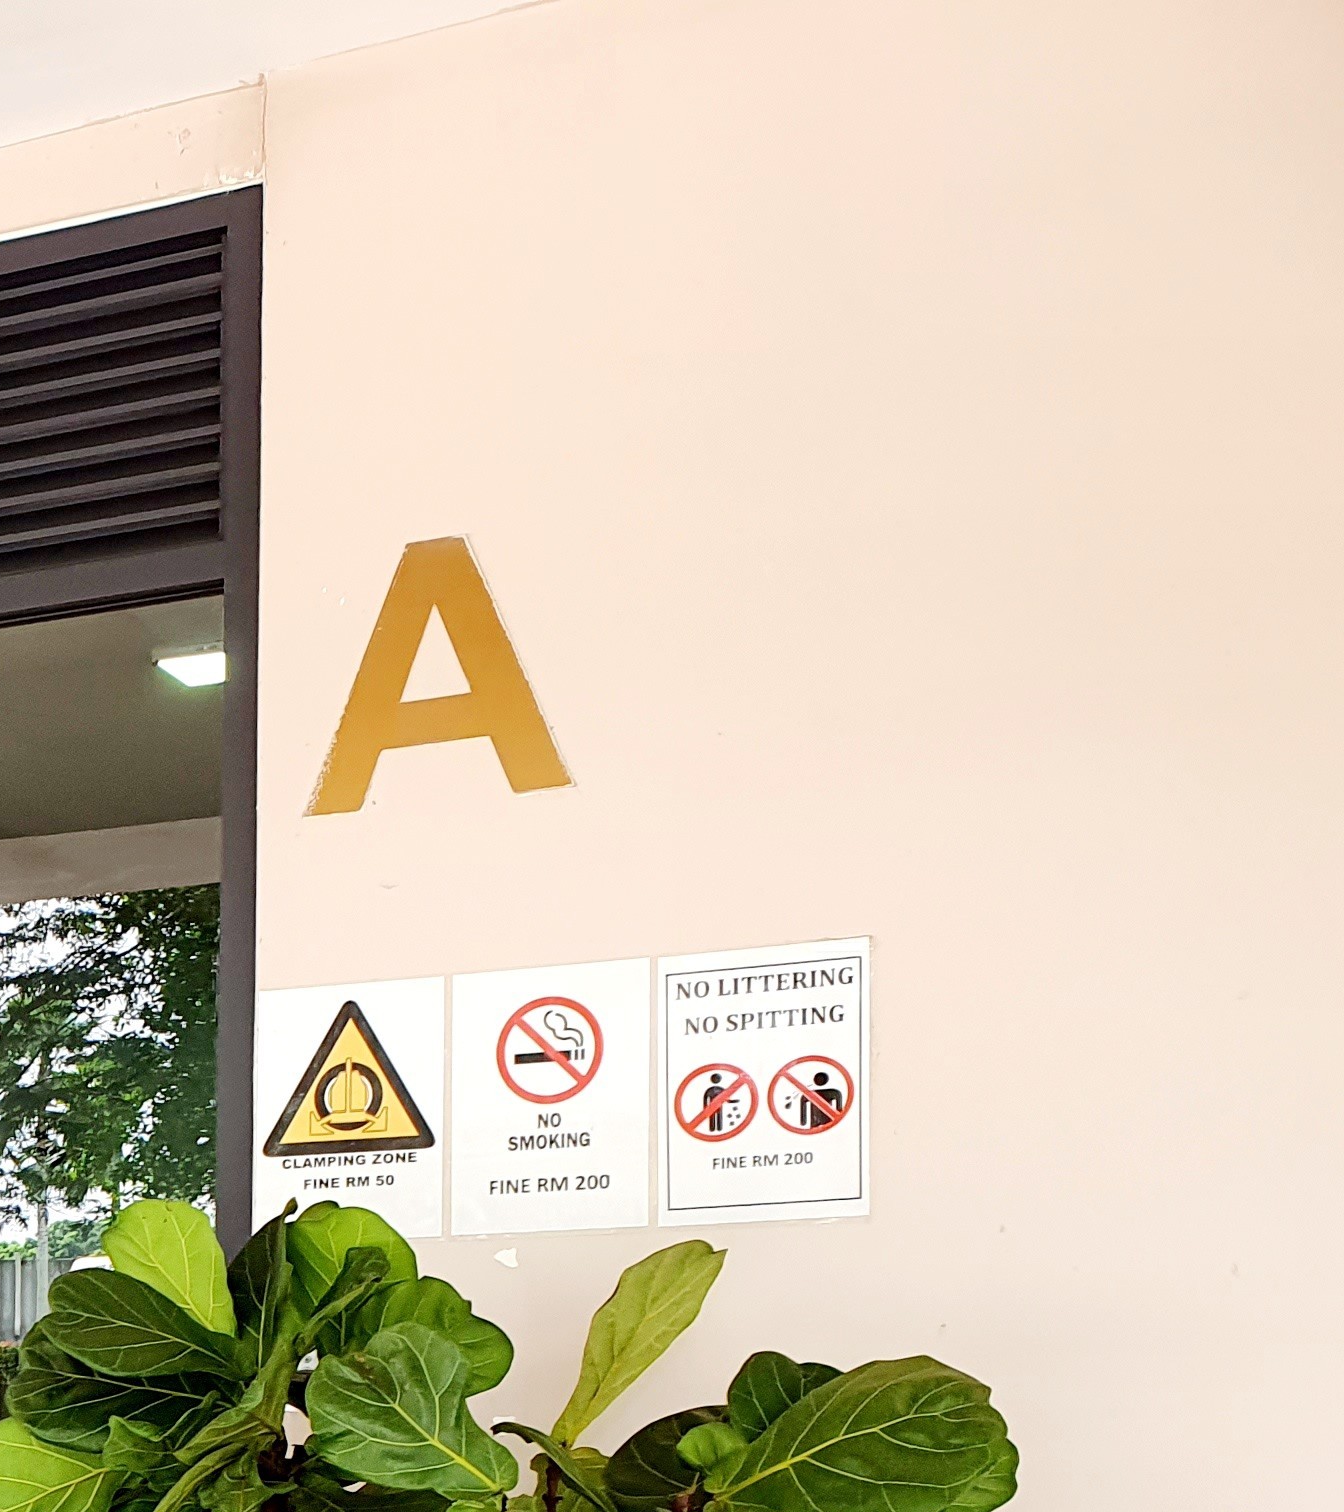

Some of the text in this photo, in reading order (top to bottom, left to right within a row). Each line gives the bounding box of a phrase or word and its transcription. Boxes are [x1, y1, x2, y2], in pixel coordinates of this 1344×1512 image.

[303, 535, 576, 817] A
[676, 966, 854, 1000] NO LITTERING
[684, 1004, 844, 1035] NO SPITTING
[537, 1112, 562, 1129] NO
[507, 1131, 591, 1151] SMOKING
[282, 1152, 418, 1170] CLAMPING ZONE
[712, 1151, 814, 1170] FINE RM 200
[303, 1174, 395, 1190] FINE RM 50
[489, 1174, 611, 1195] FINE RM 200
